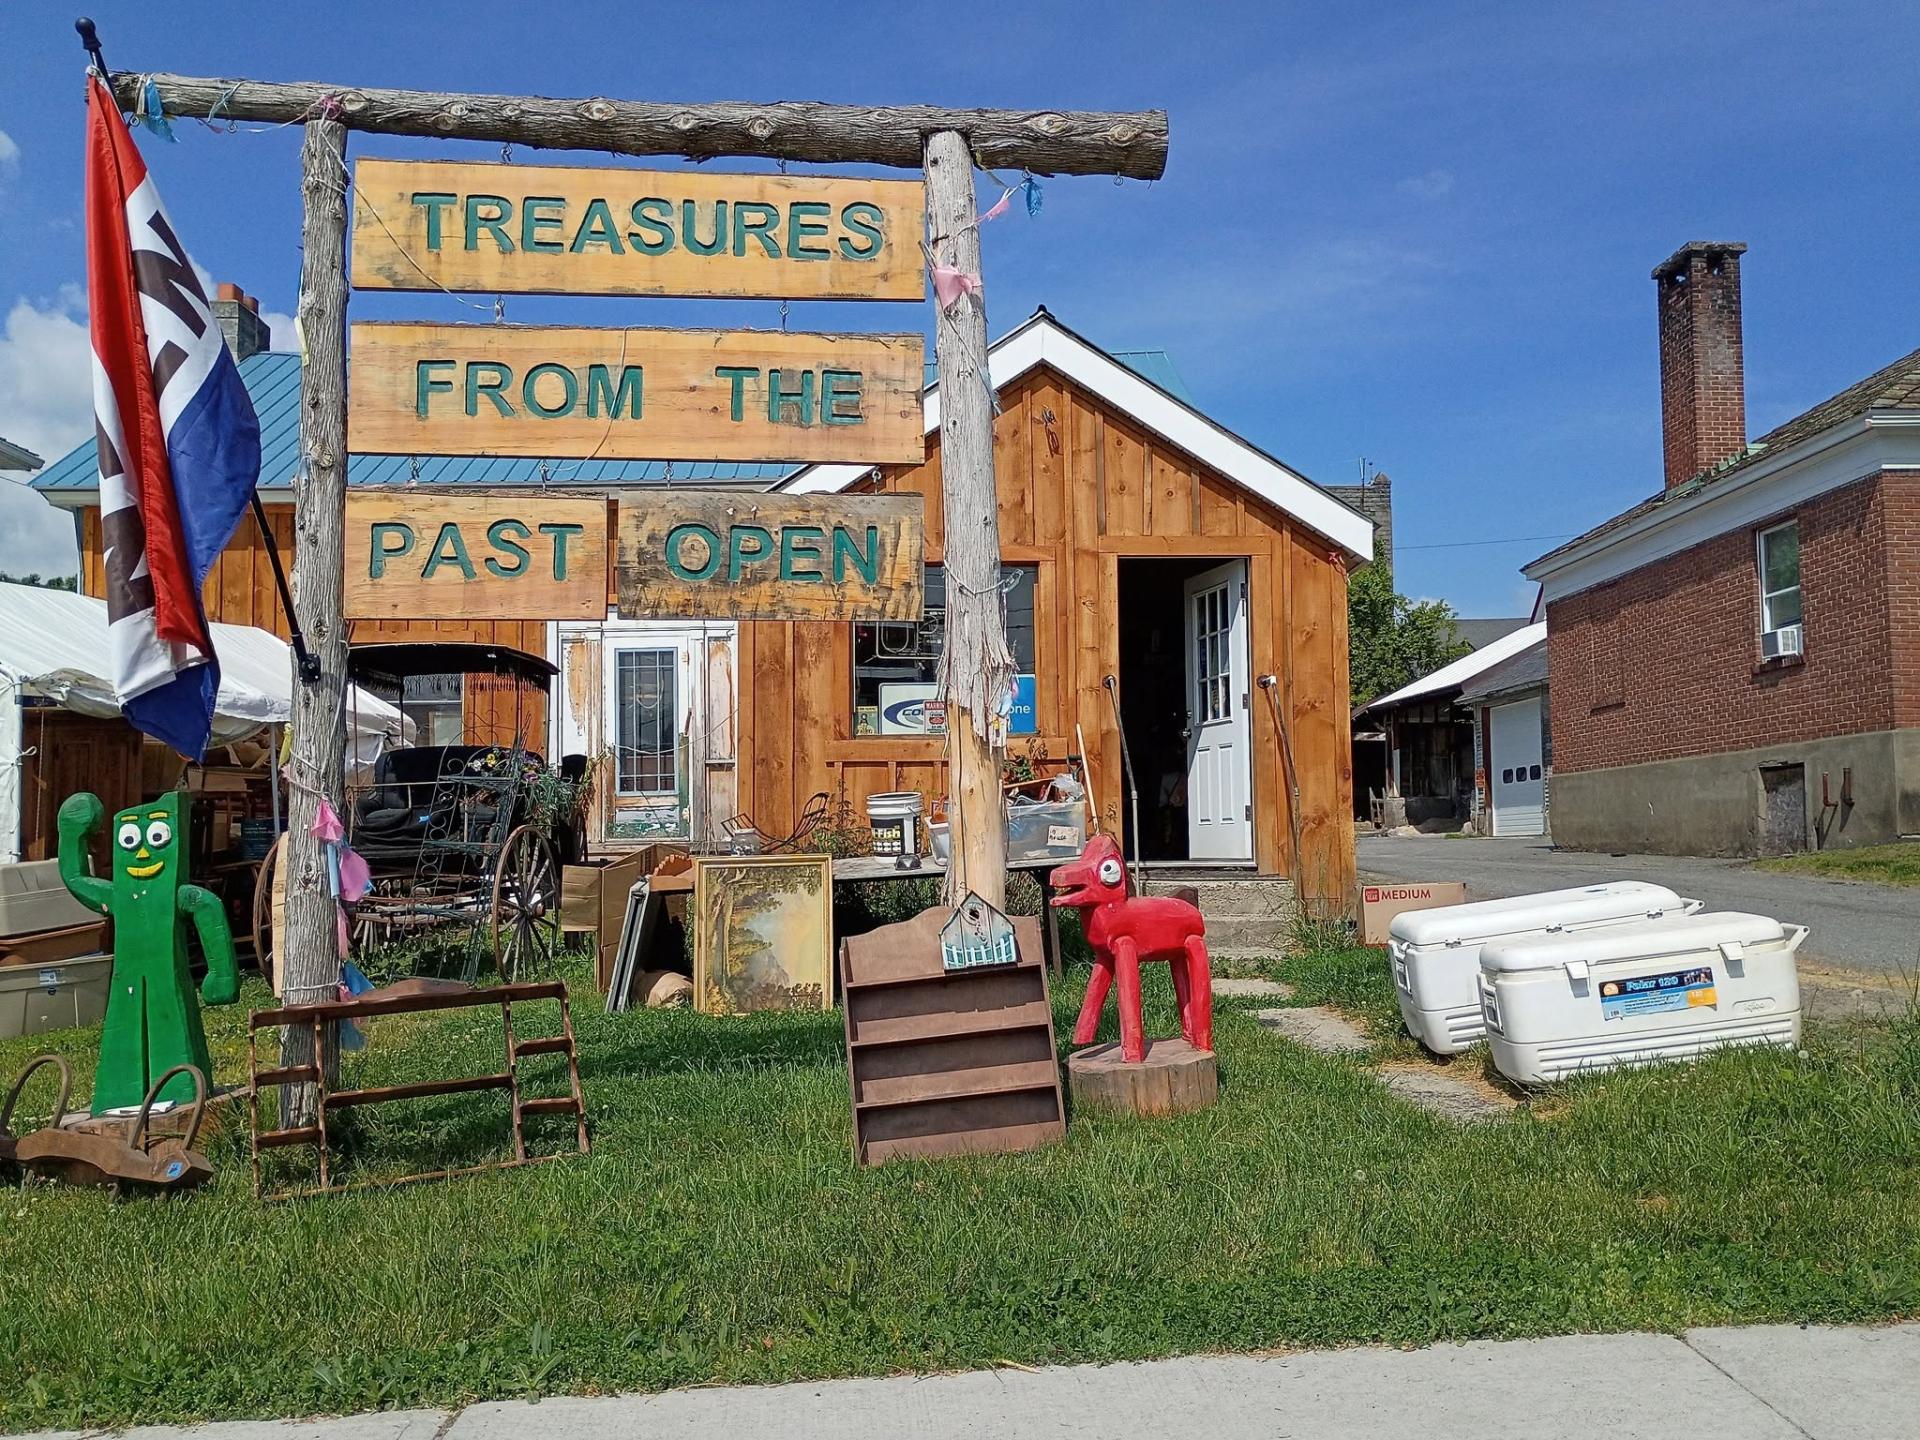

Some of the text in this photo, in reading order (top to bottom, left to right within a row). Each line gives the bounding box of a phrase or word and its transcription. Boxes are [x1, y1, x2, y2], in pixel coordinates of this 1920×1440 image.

[411, 192, 885, 261] TREASURES
[415, 358, 864, 426] FROM THE
[369, 518, 878, 586] PAST OPEN
[1381, 889, 1431, 900] MEDIUM
